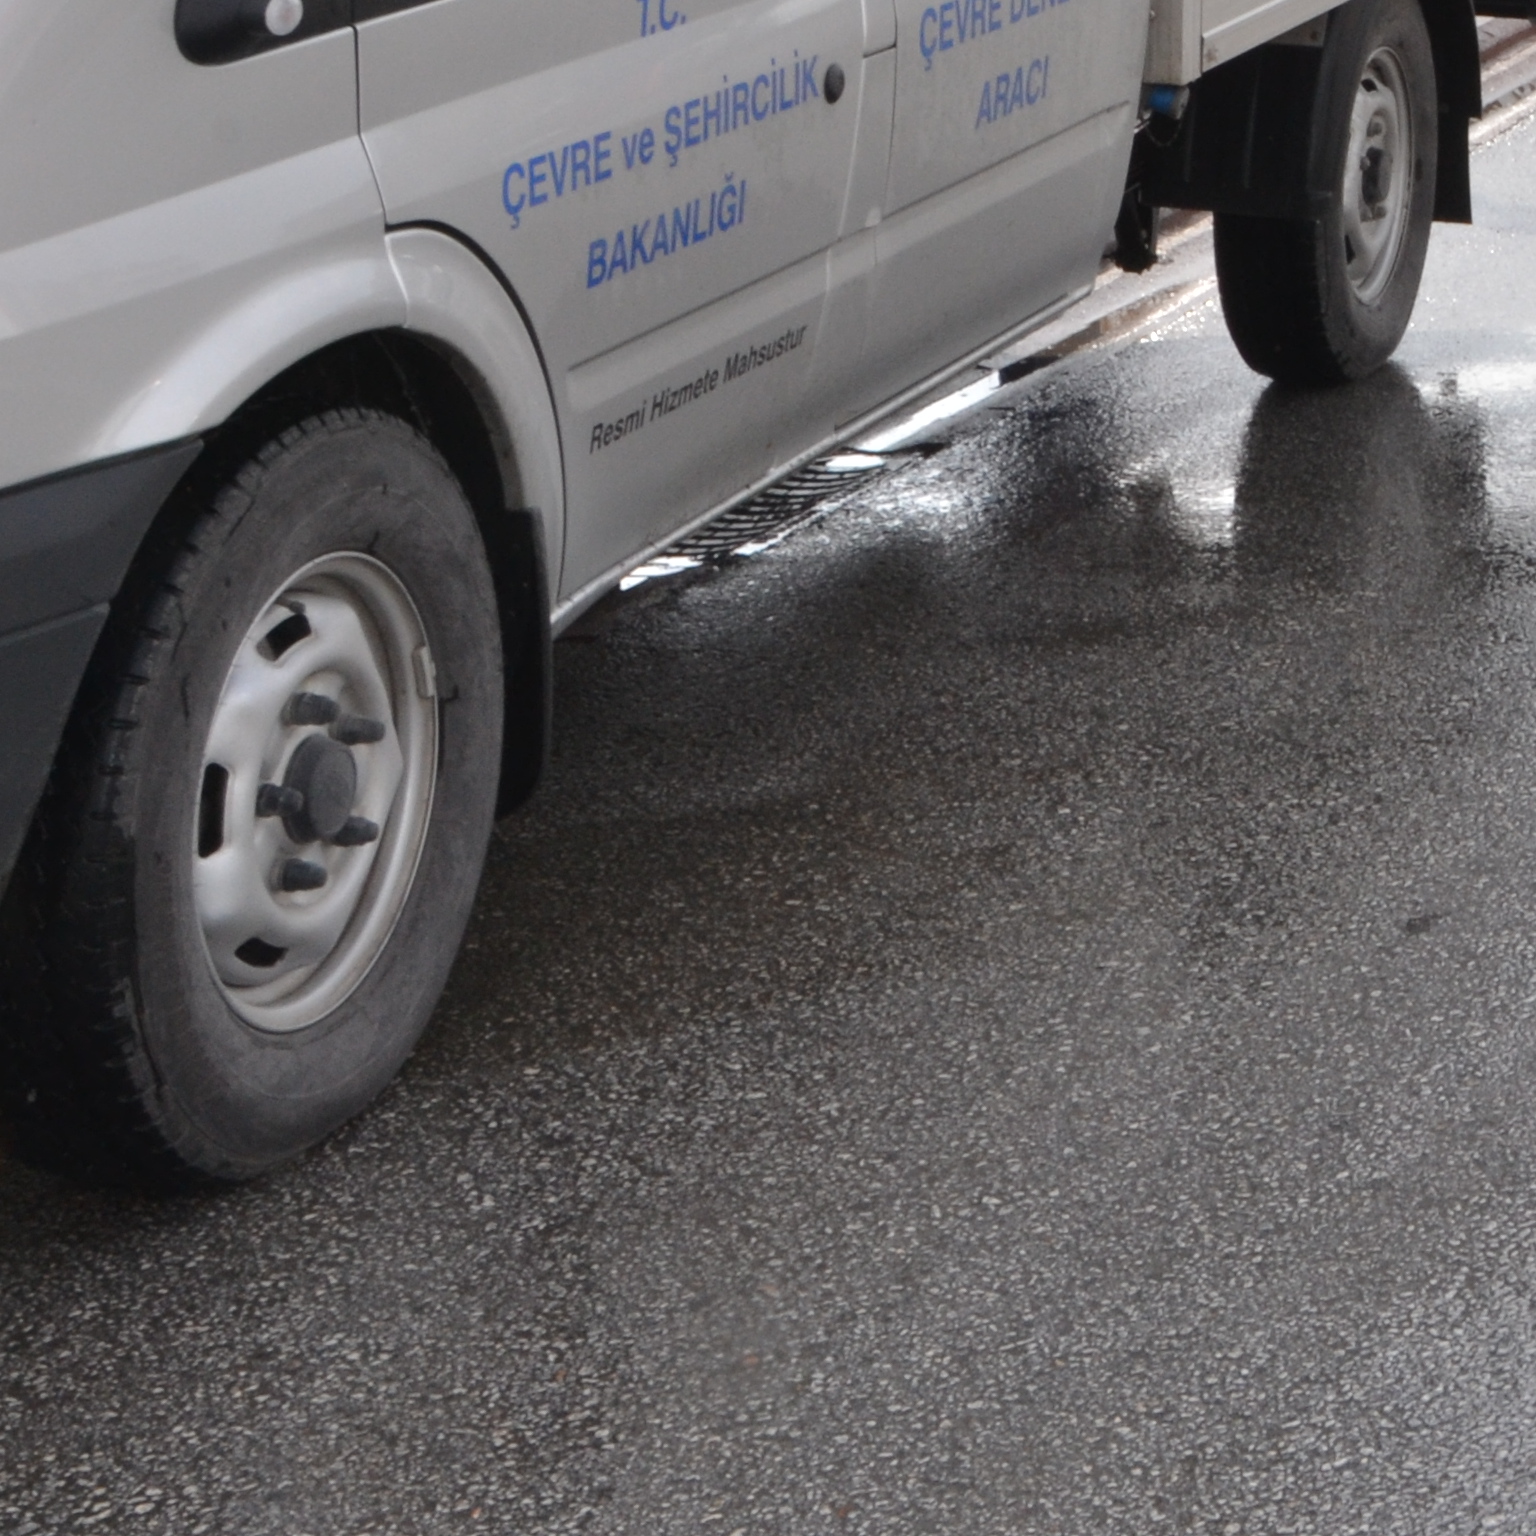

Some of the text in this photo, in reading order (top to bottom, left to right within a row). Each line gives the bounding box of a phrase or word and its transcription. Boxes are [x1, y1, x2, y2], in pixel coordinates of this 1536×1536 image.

[502, 48, 819, 230] ÇEVRE ve ŞEHİRCİLİK
[974, 54, 1050, 130] ARACI
[586, 171, 747, 290] BAKANLIĞI
[589, 324, 808, 455] Resmi Hizmete Mahsustur
